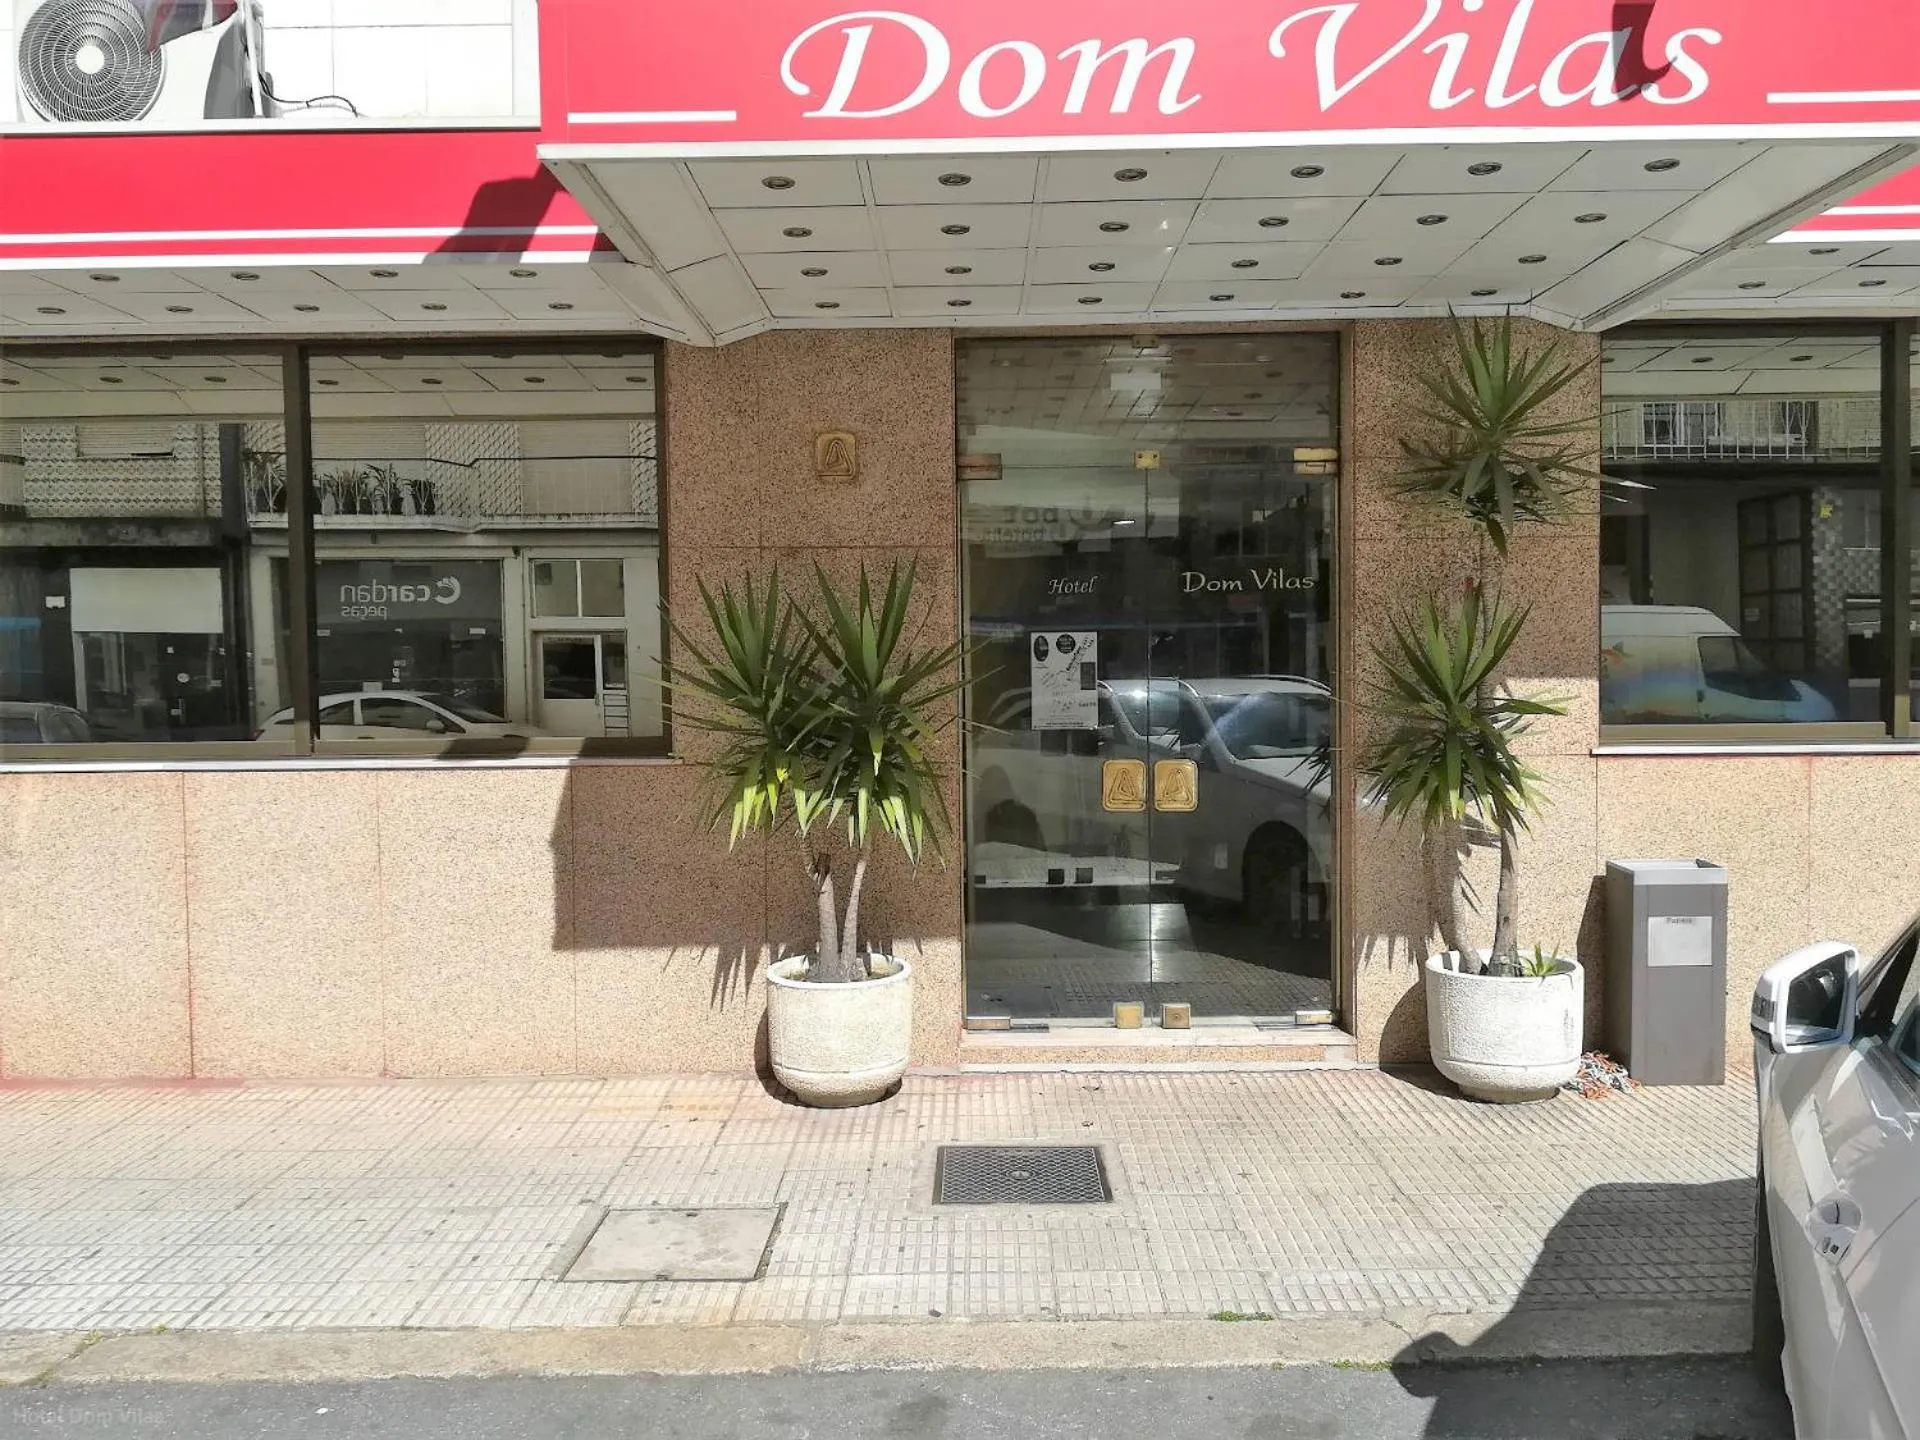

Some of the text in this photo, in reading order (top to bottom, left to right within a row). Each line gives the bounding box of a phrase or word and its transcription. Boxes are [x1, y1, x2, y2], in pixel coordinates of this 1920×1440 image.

[780, 0, 1722, 118] Dom Vilas
[1047, 575, 1098, 594] Hotel
[1181, 567, 1315, 592] Dom Vilas
